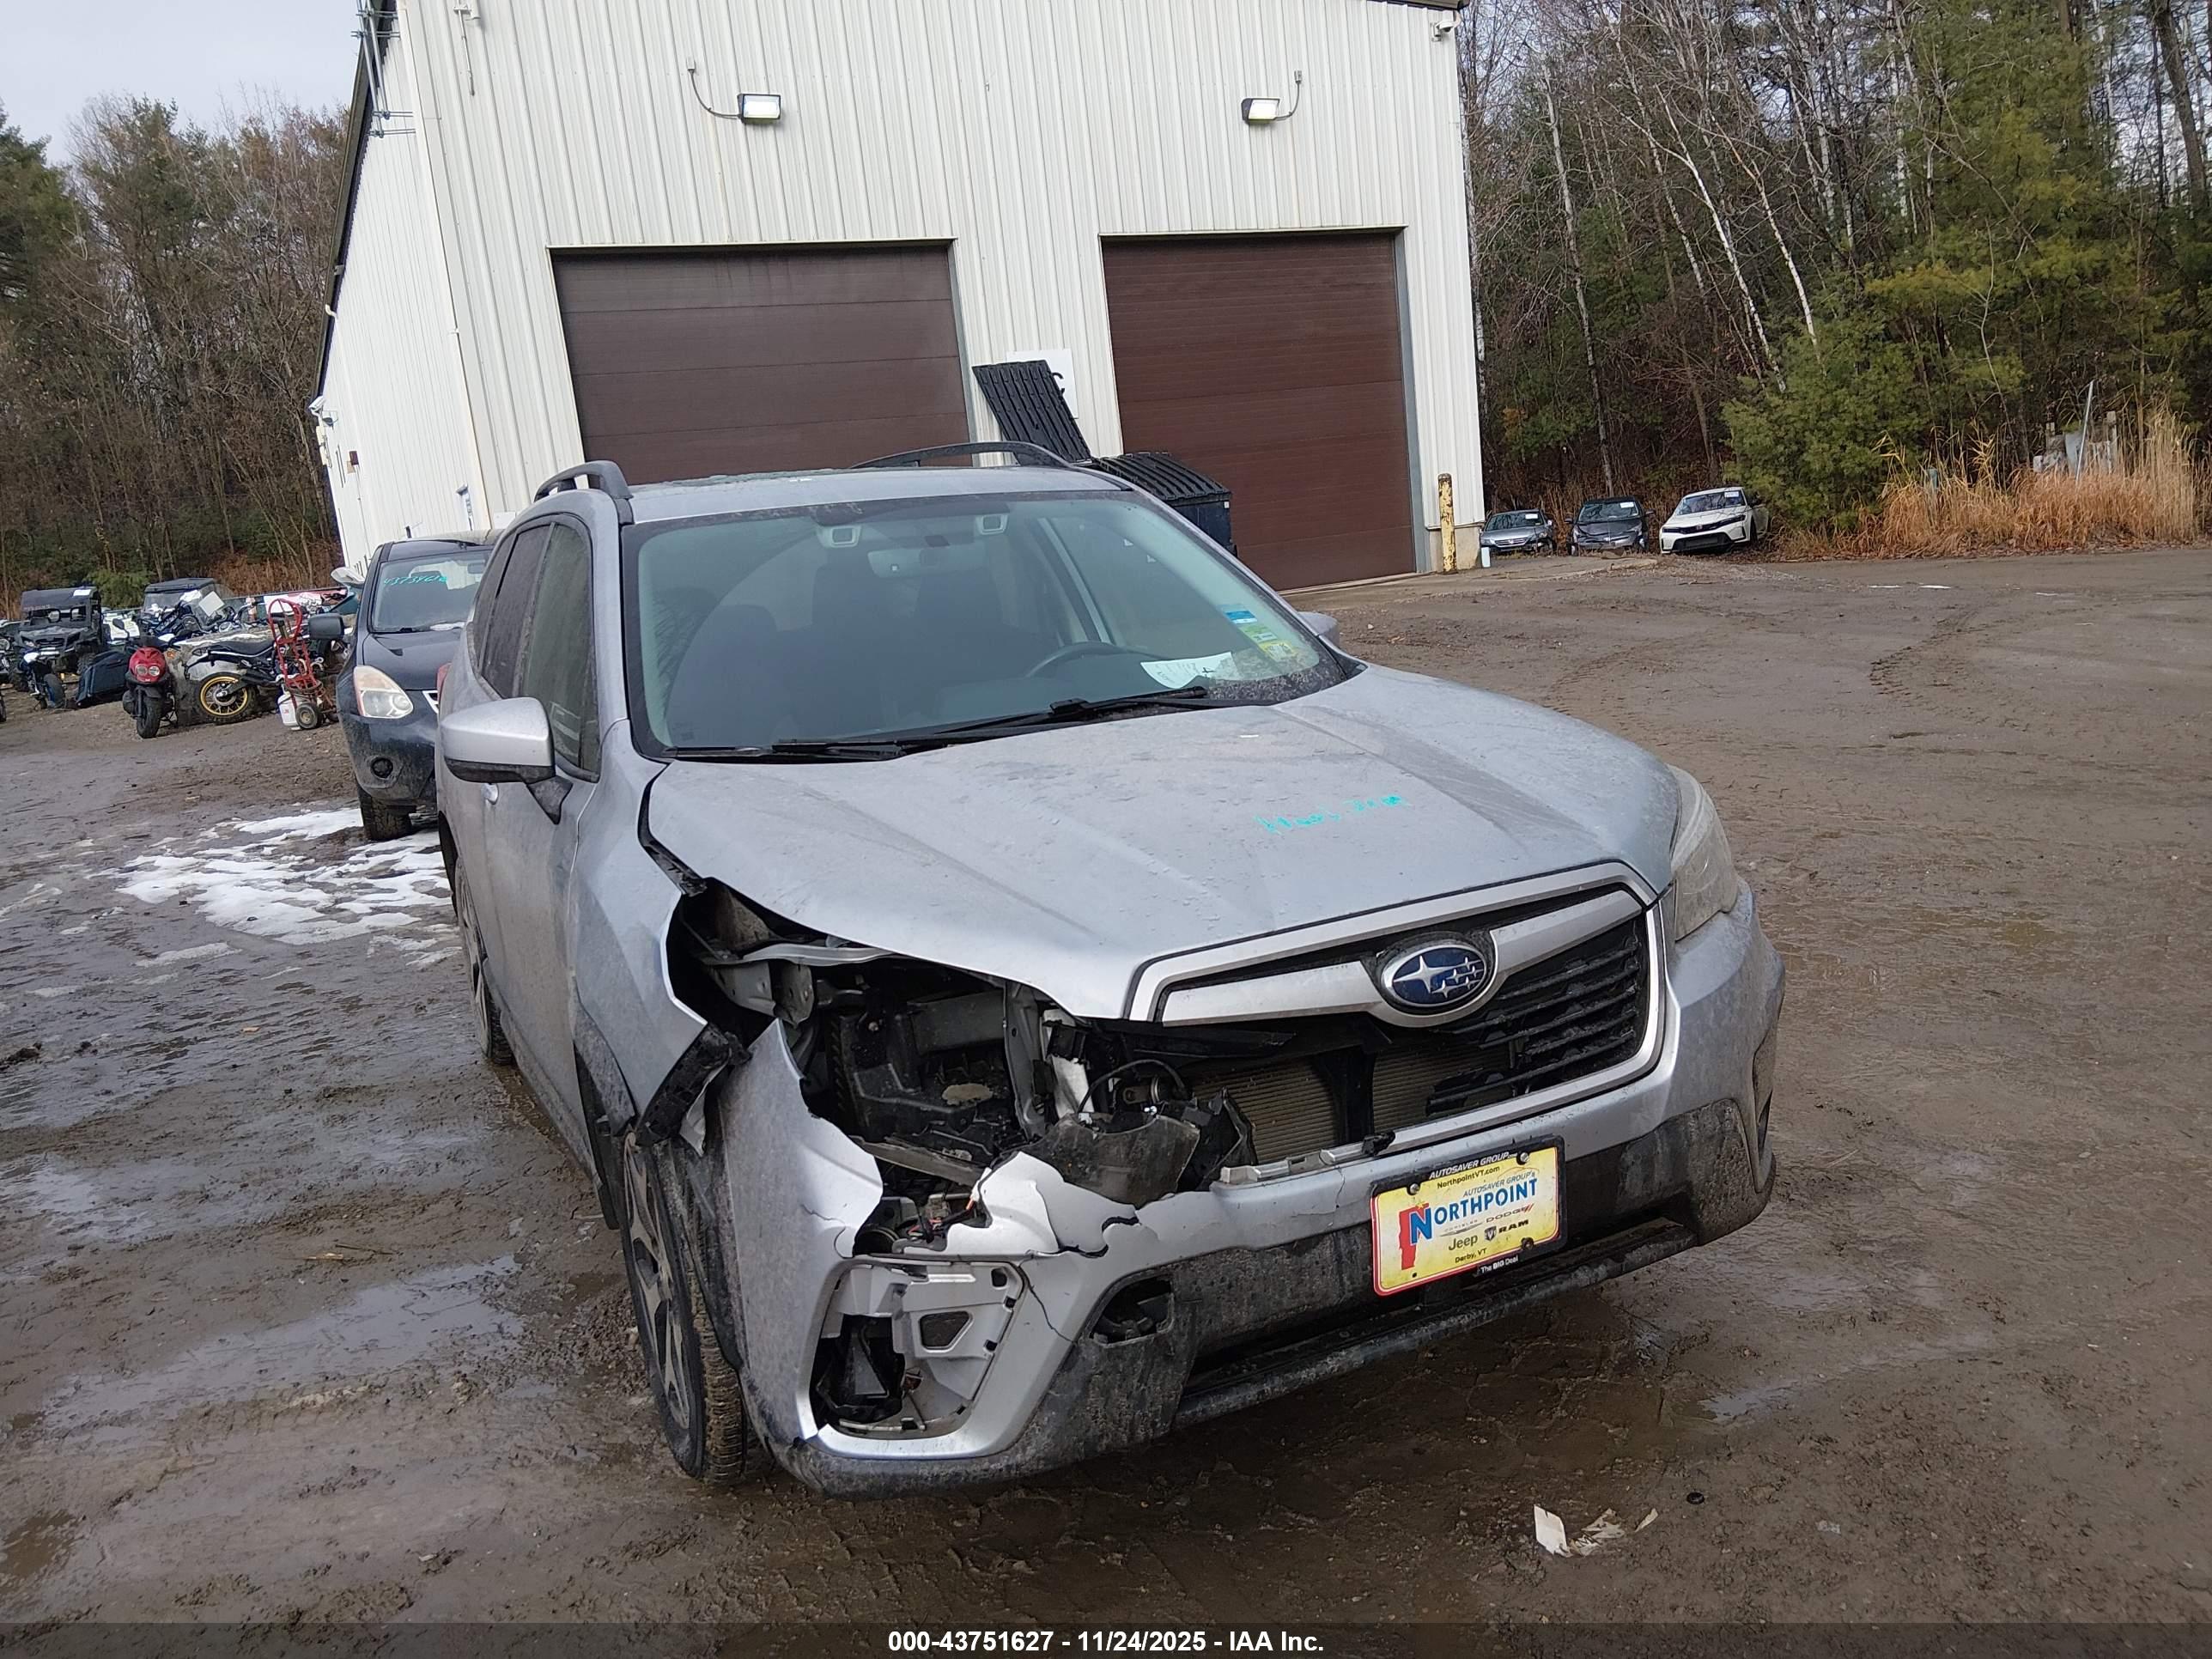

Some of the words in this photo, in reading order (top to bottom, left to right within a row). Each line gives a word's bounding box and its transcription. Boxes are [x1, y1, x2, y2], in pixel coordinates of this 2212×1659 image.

[1429, 1159, 1479, 1180] AUTOSAVER
[1462, 1177, 1505, 1198] AUTOSAVER
[1410, 1178, 1538, 1244] NORTHPOINT
[1498, 1219, 1529, 1234] RAM
[1448, 1235, 1478, 1251] Jeep
